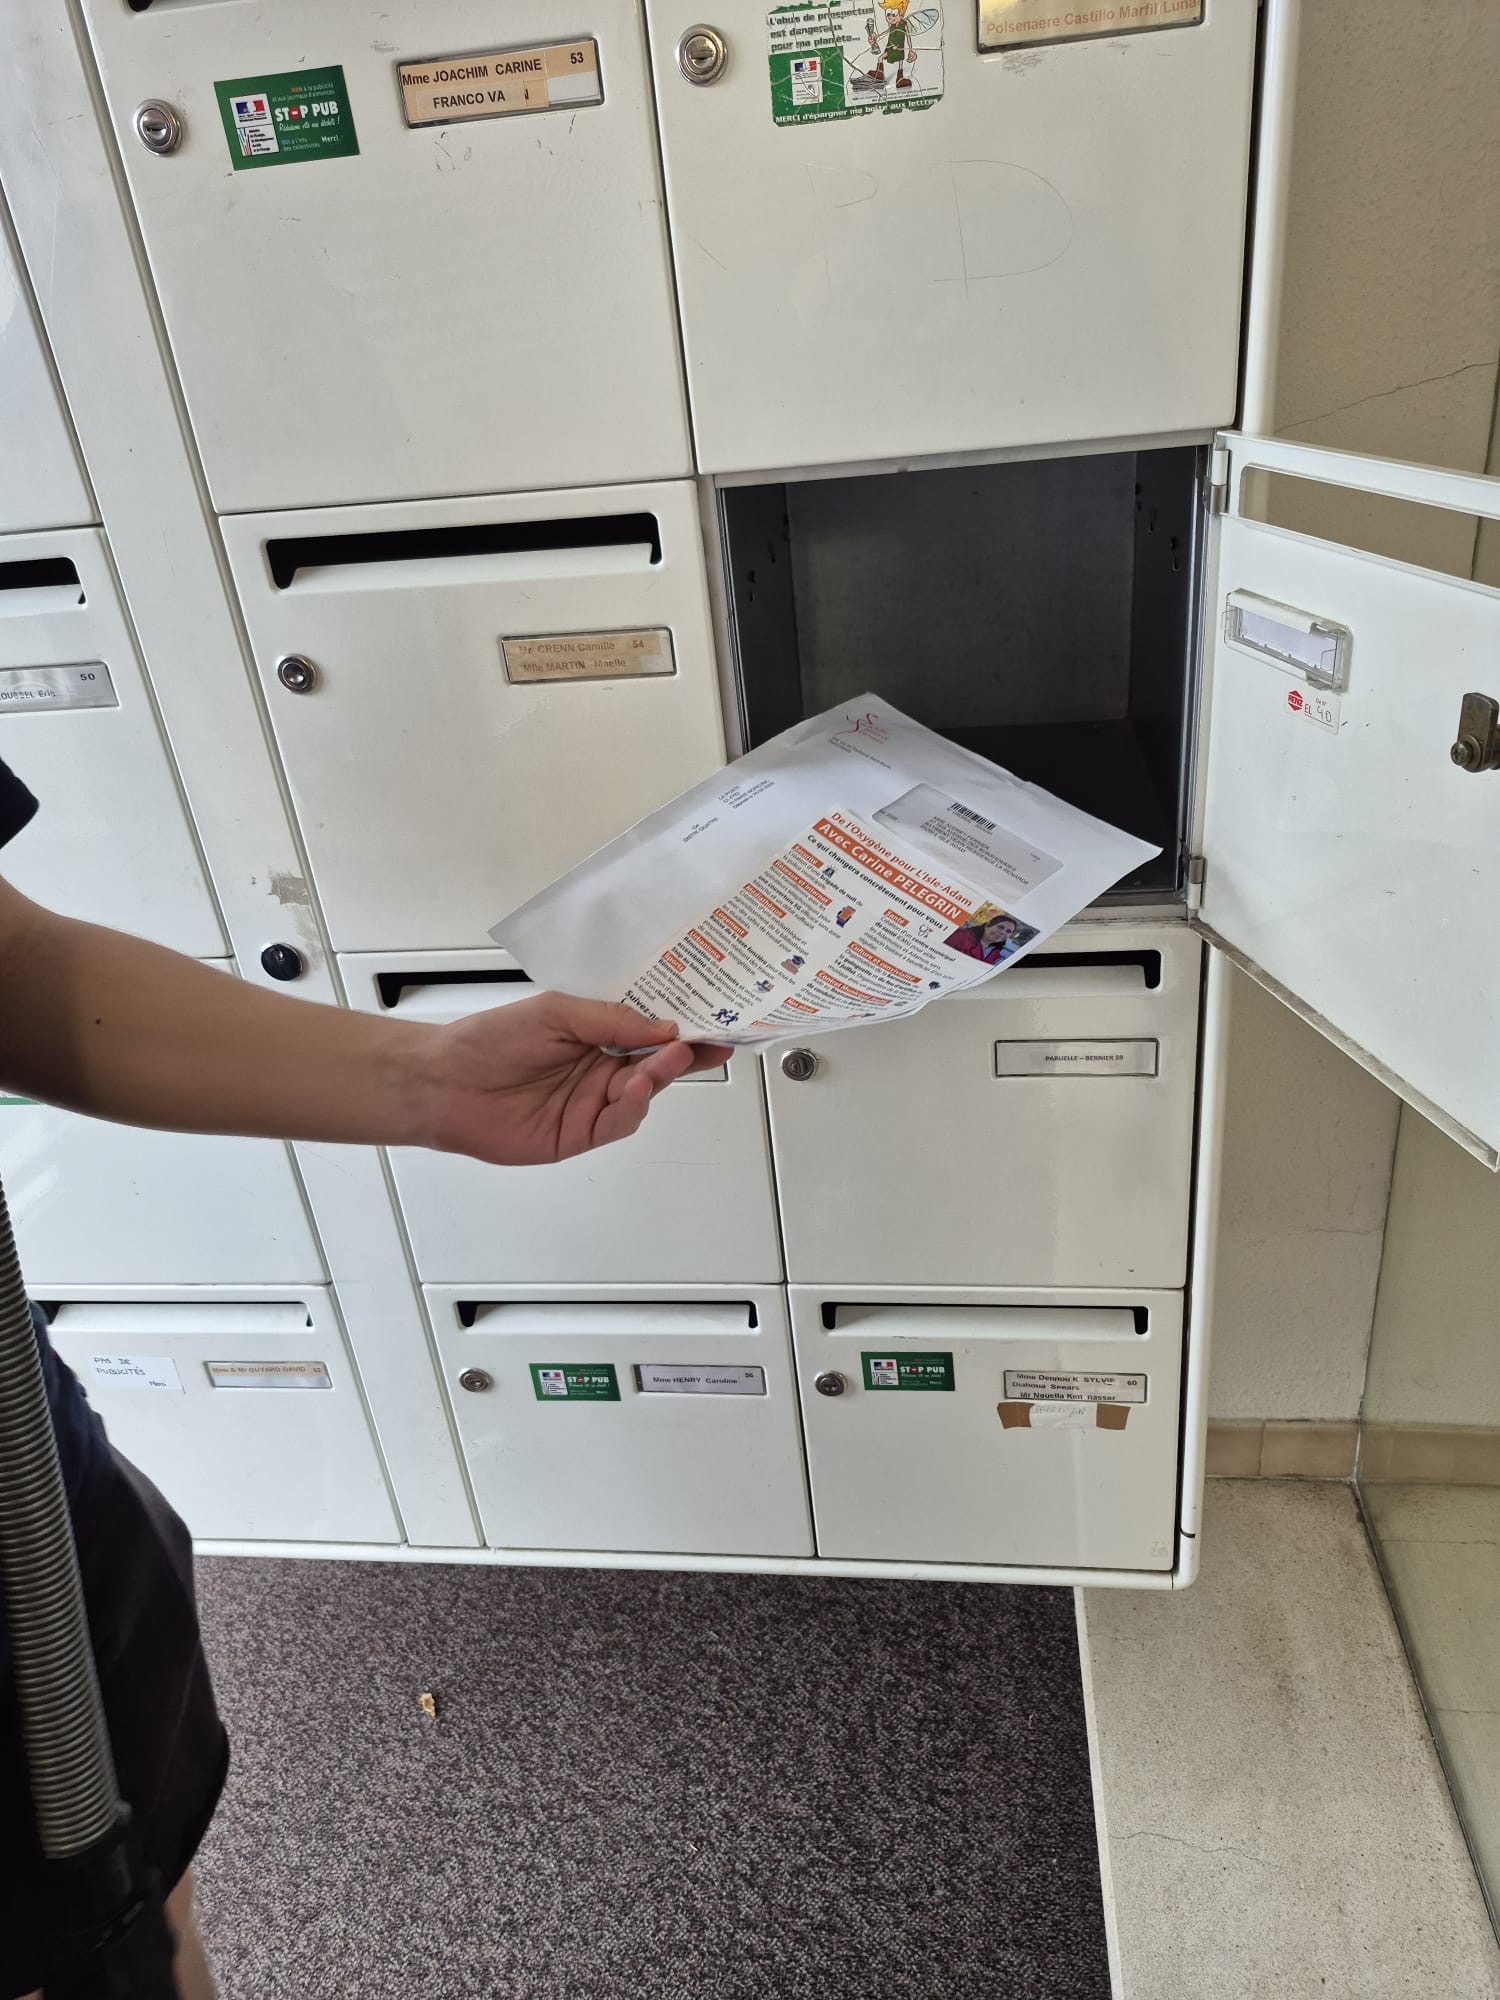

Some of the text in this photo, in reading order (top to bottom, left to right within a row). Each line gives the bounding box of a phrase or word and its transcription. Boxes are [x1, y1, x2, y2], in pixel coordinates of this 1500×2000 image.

[769, 7, 875, 26] L'abus de prospectus
[986, 0, 1198, 36] Polsenaere Castillo Marfil Luna
[770, 28, 787, 39] est
[770, 42, 793, 53] pour
[796, 40, 811, 48] ma
[570, 52, 584, 65] 53
[402, 58, 543, 86] Mme JOACHIM CARINE
[433, 91, 485, 109] FRANCO
[487, 89, 506, 103] VA
[311, 101, 339, 117] PUB
[775, 113, 801, 124] MERCI
[850, 107, 863, 115] ma
[890, 102, 906, 111] aux
[321, 134, 339, 144] Merci
[537, 645, 576, 655] CRENN
[577, 641, 616, 652] Camille
[632, 640, 645, 650] 54
[545, 661, 586, 673] MARTIN
[80, 673, 96, 682] 50
[0, 690, 57, 701] OUSSEL Eric
[830, 812, 974, 907] De l'Oxygène pour L'Isle-Adam
[818, 822, 852, 847] Avec
[849, 845, 895, 877] Carine
[892, 874, 962, 919] PELEGRIN
[806, 835, 817, 843] Ce
[814, 841, 830, 853] qui
[826, 849, 862, 875] changera
[859, 872, 909, 905] concrètement
[906, 904, 925, 917] pour
[924, 915, 944, 928] vous
[1087, 1393, 1116, 1401] nasser
